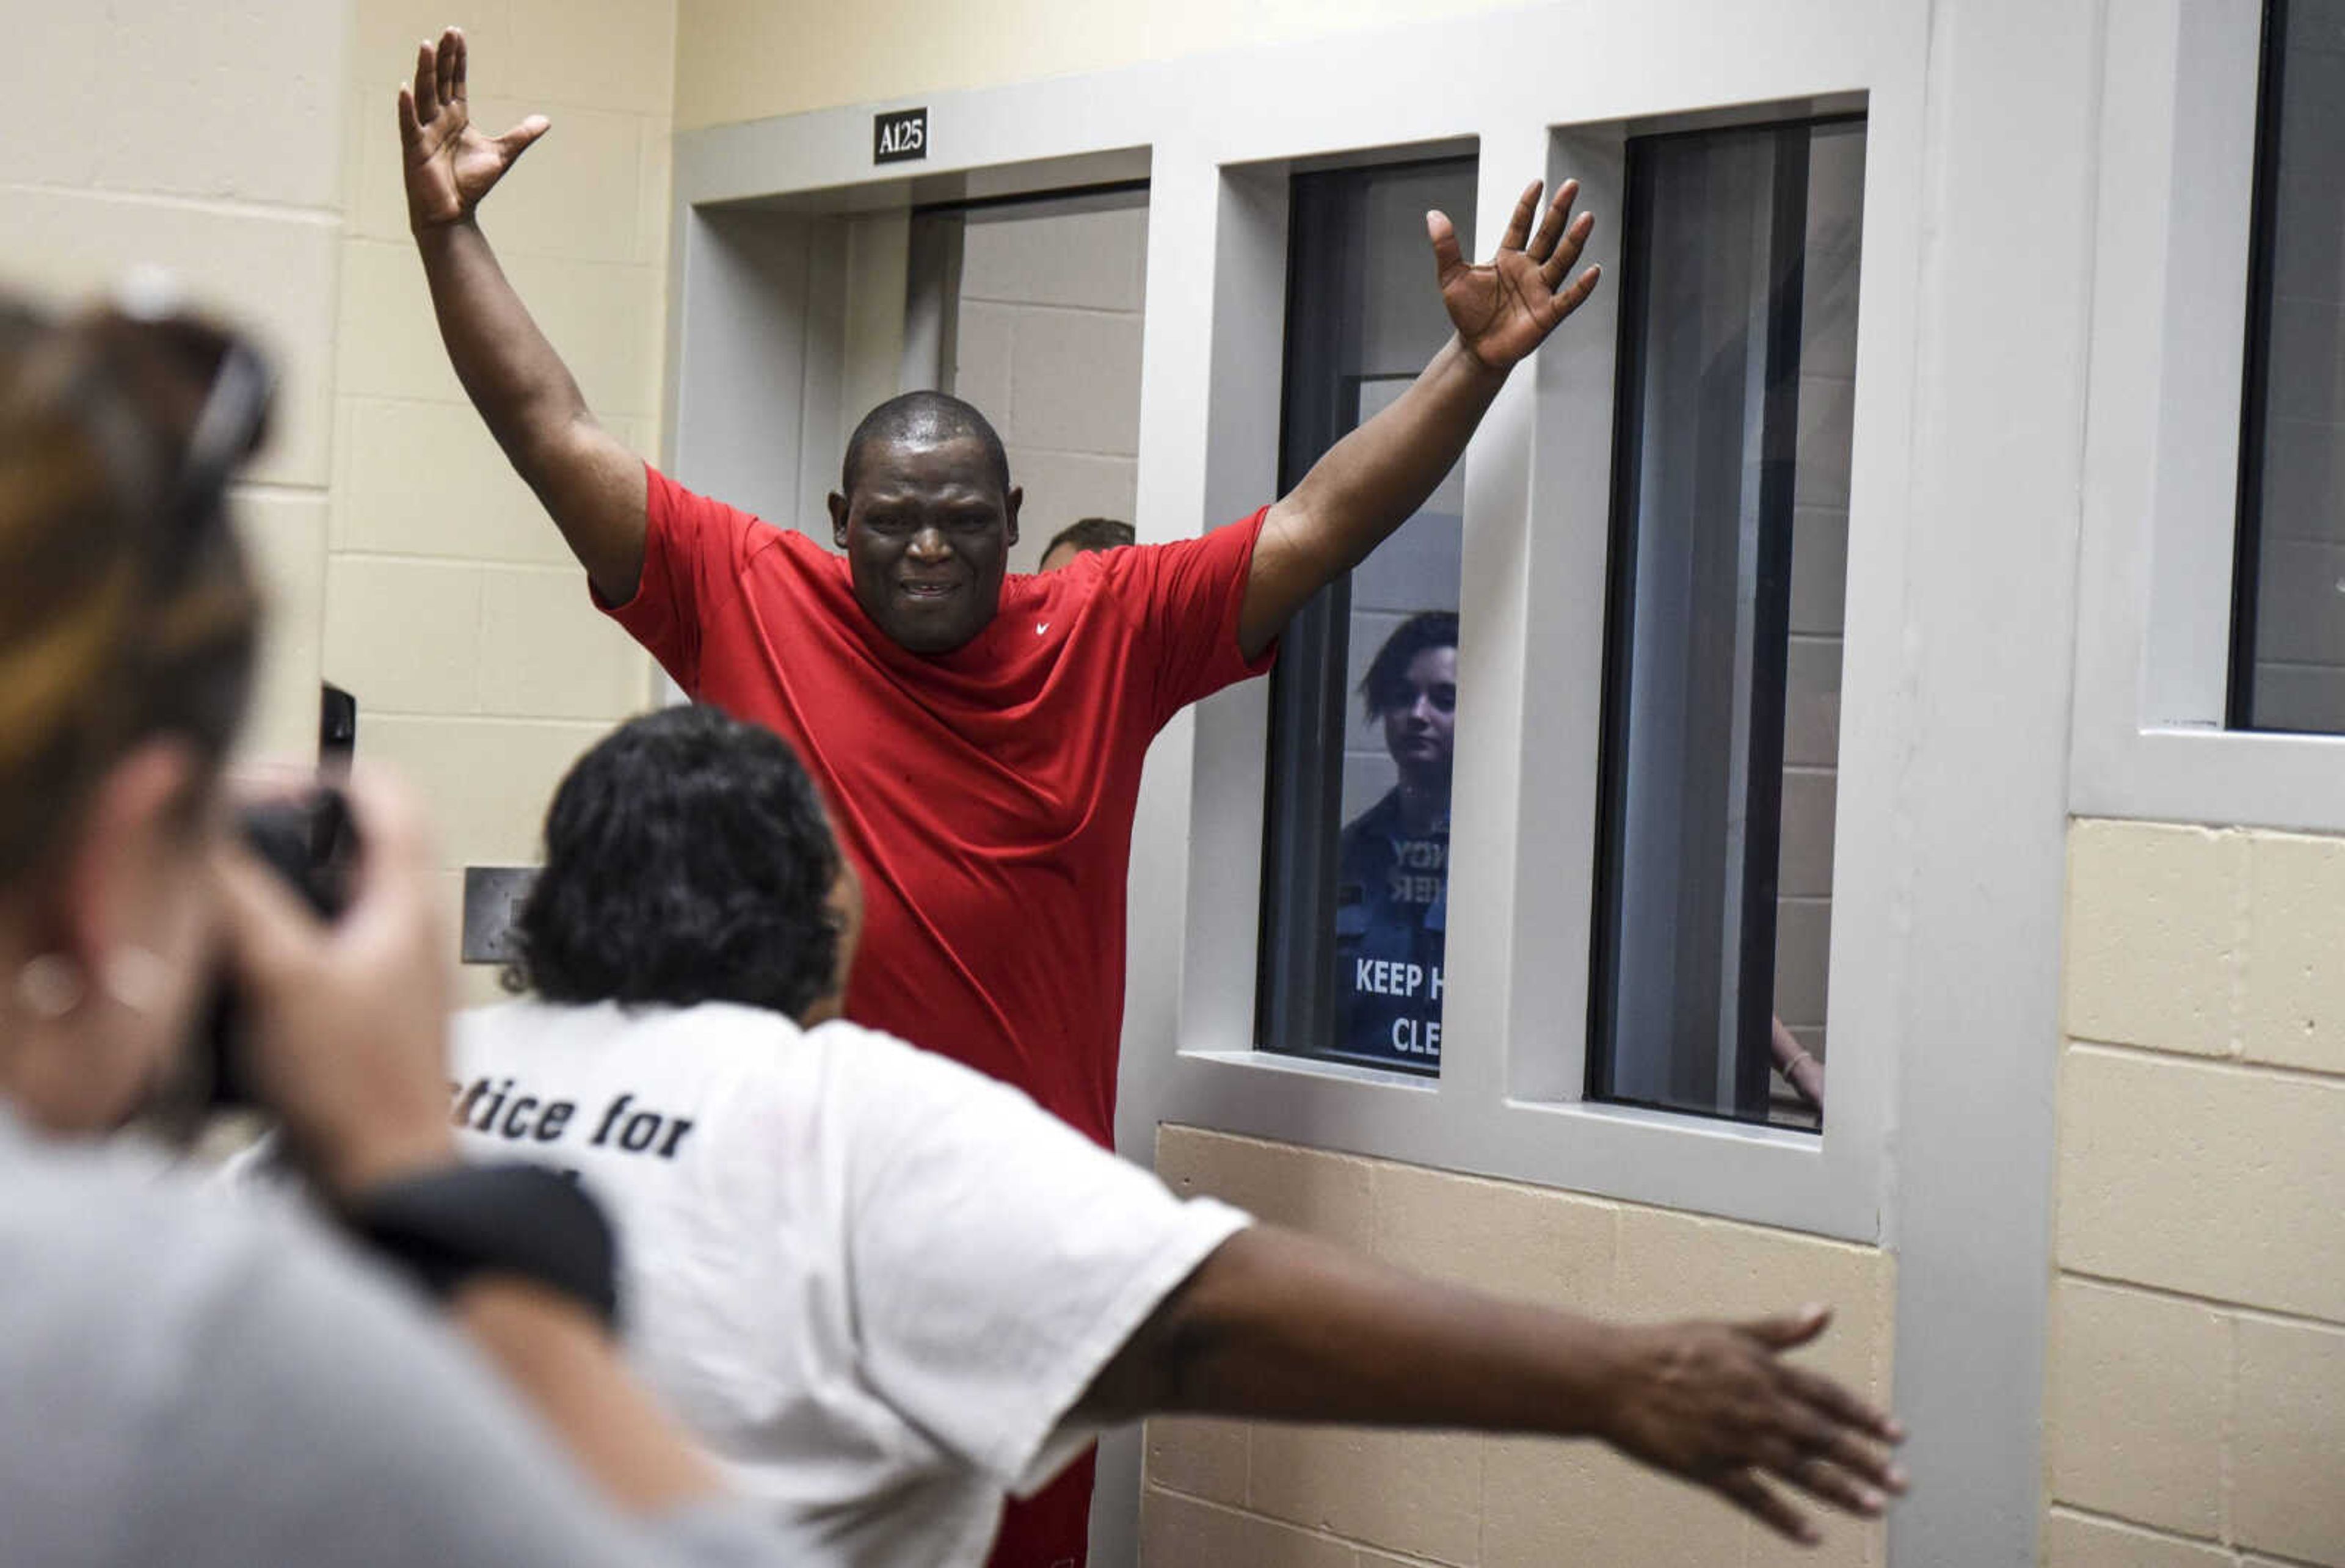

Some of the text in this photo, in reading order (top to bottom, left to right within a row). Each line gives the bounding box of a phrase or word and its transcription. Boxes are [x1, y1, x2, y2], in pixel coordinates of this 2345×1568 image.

[879, 118, 923, 153] A125
[1356, 958, 1423, 997] KEEP
[1392, 1018, 1441, 1056] CLE
[450, 1077, 694, 1160] tice for
